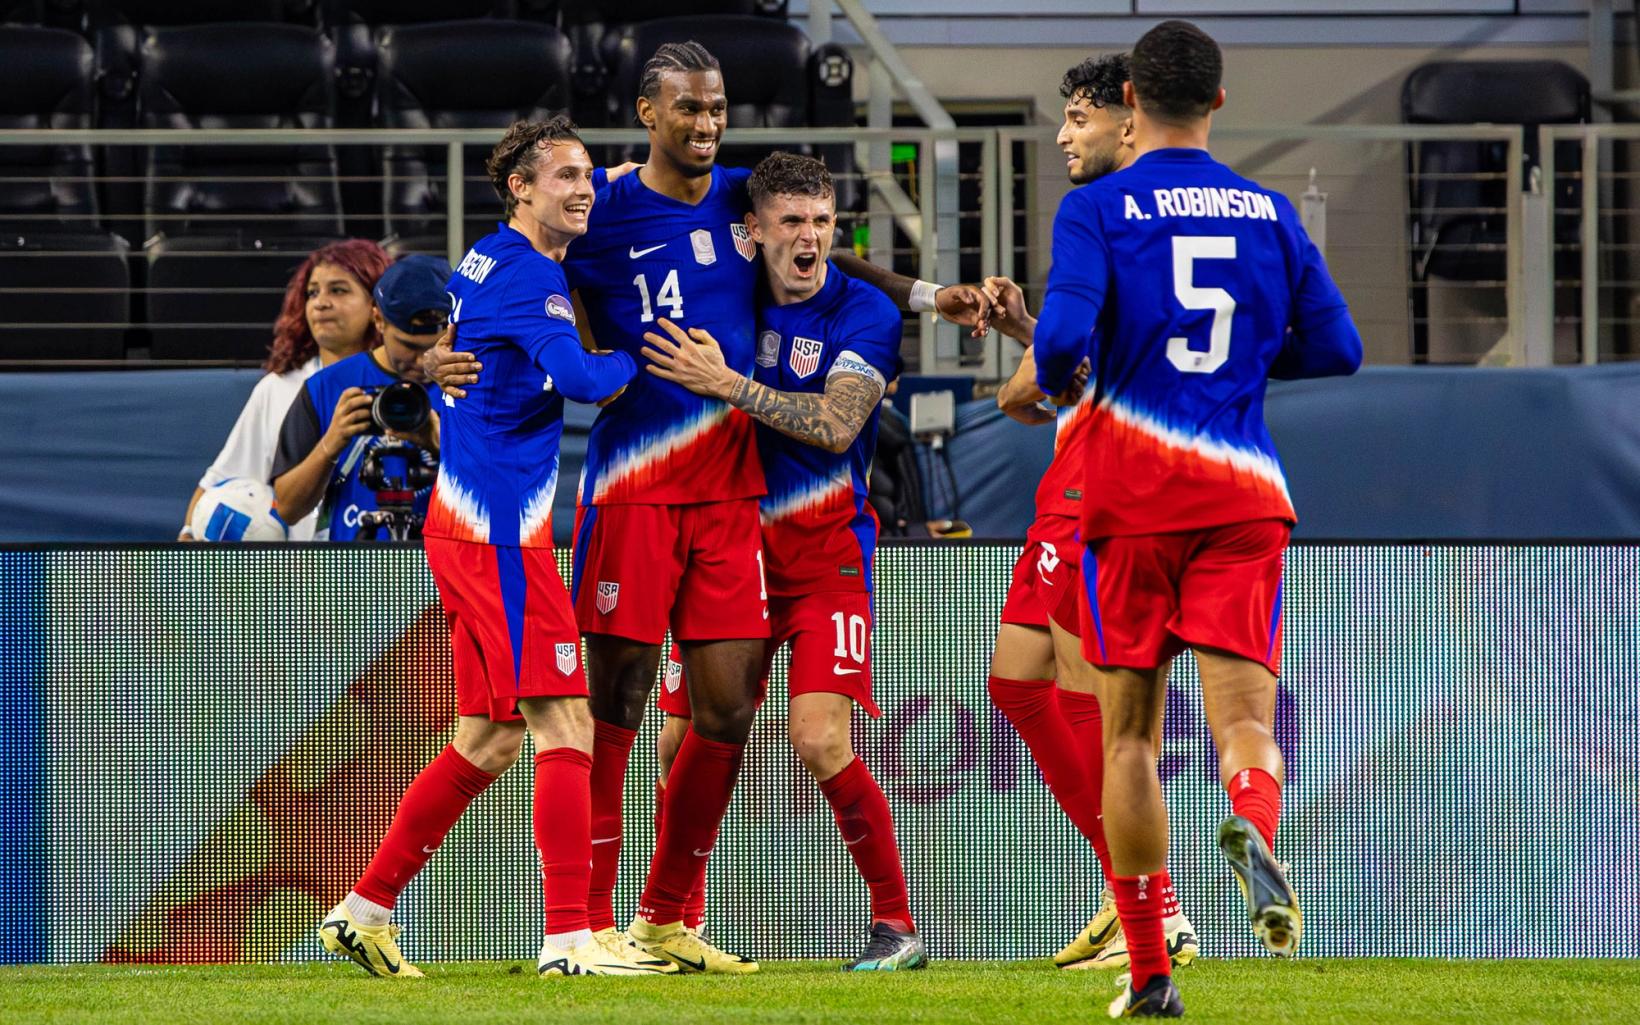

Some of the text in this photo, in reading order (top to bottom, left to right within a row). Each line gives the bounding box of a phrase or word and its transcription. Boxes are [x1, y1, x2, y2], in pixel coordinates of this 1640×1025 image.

[1124, 187, 1278, 222] A. ROBINSON
[633, 270, 684, 323] 14
[1166, 236, 1237, 374] 5
[795, 338, 821, 356] USA
[598, 582, 618, 597] USA
[556, 644, 575, 658] USA
[831, 611, 866, 665] 10
